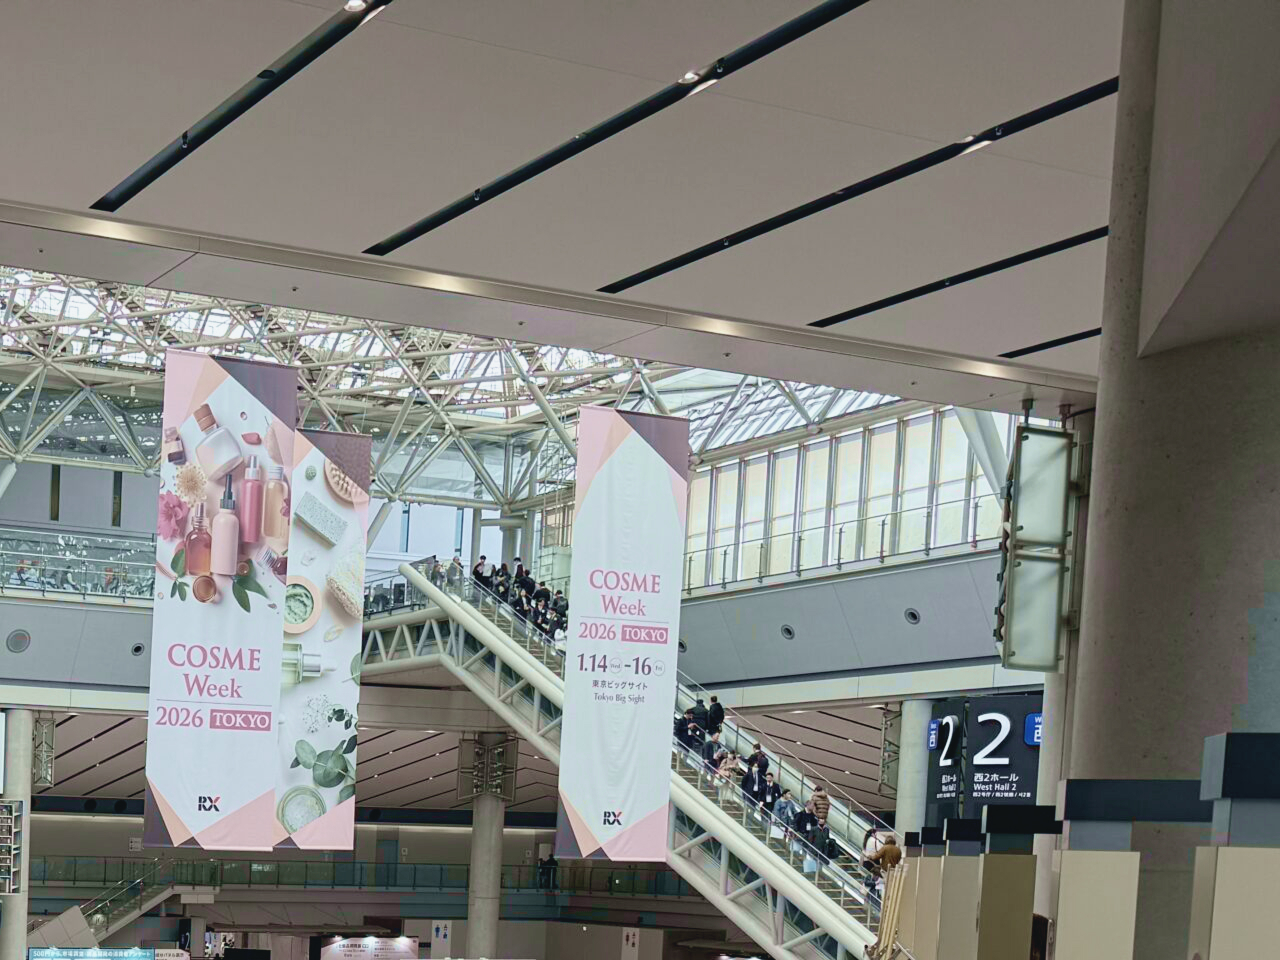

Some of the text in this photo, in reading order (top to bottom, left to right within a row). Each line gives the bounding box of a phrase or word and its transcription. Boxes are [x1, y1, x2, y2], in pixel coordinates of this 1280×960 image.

[589, 569, 660, 594] COSME
[601, 594, 646, 616] Week
[578, 622, 667, 642] 2026 TOKYO
[167, 643, 261, 671] COSME
[577, 653, 608, 673] 1.14
[183, 673, 243, 698] Week
[592, 680, 648, 690] 東京ビッグサイト
[594, 693, 645, 705] Tokyo Big Sight
[155, 706, 270, 729] 2026 TOKYO
[939, 715, 954, 766] 2
[973, 712, 1011, 765] 2
[974, 773, 1019, 782] 西2ホール
[198, 796, 220, 811] RX
[603, 811, 622, 825] RX
